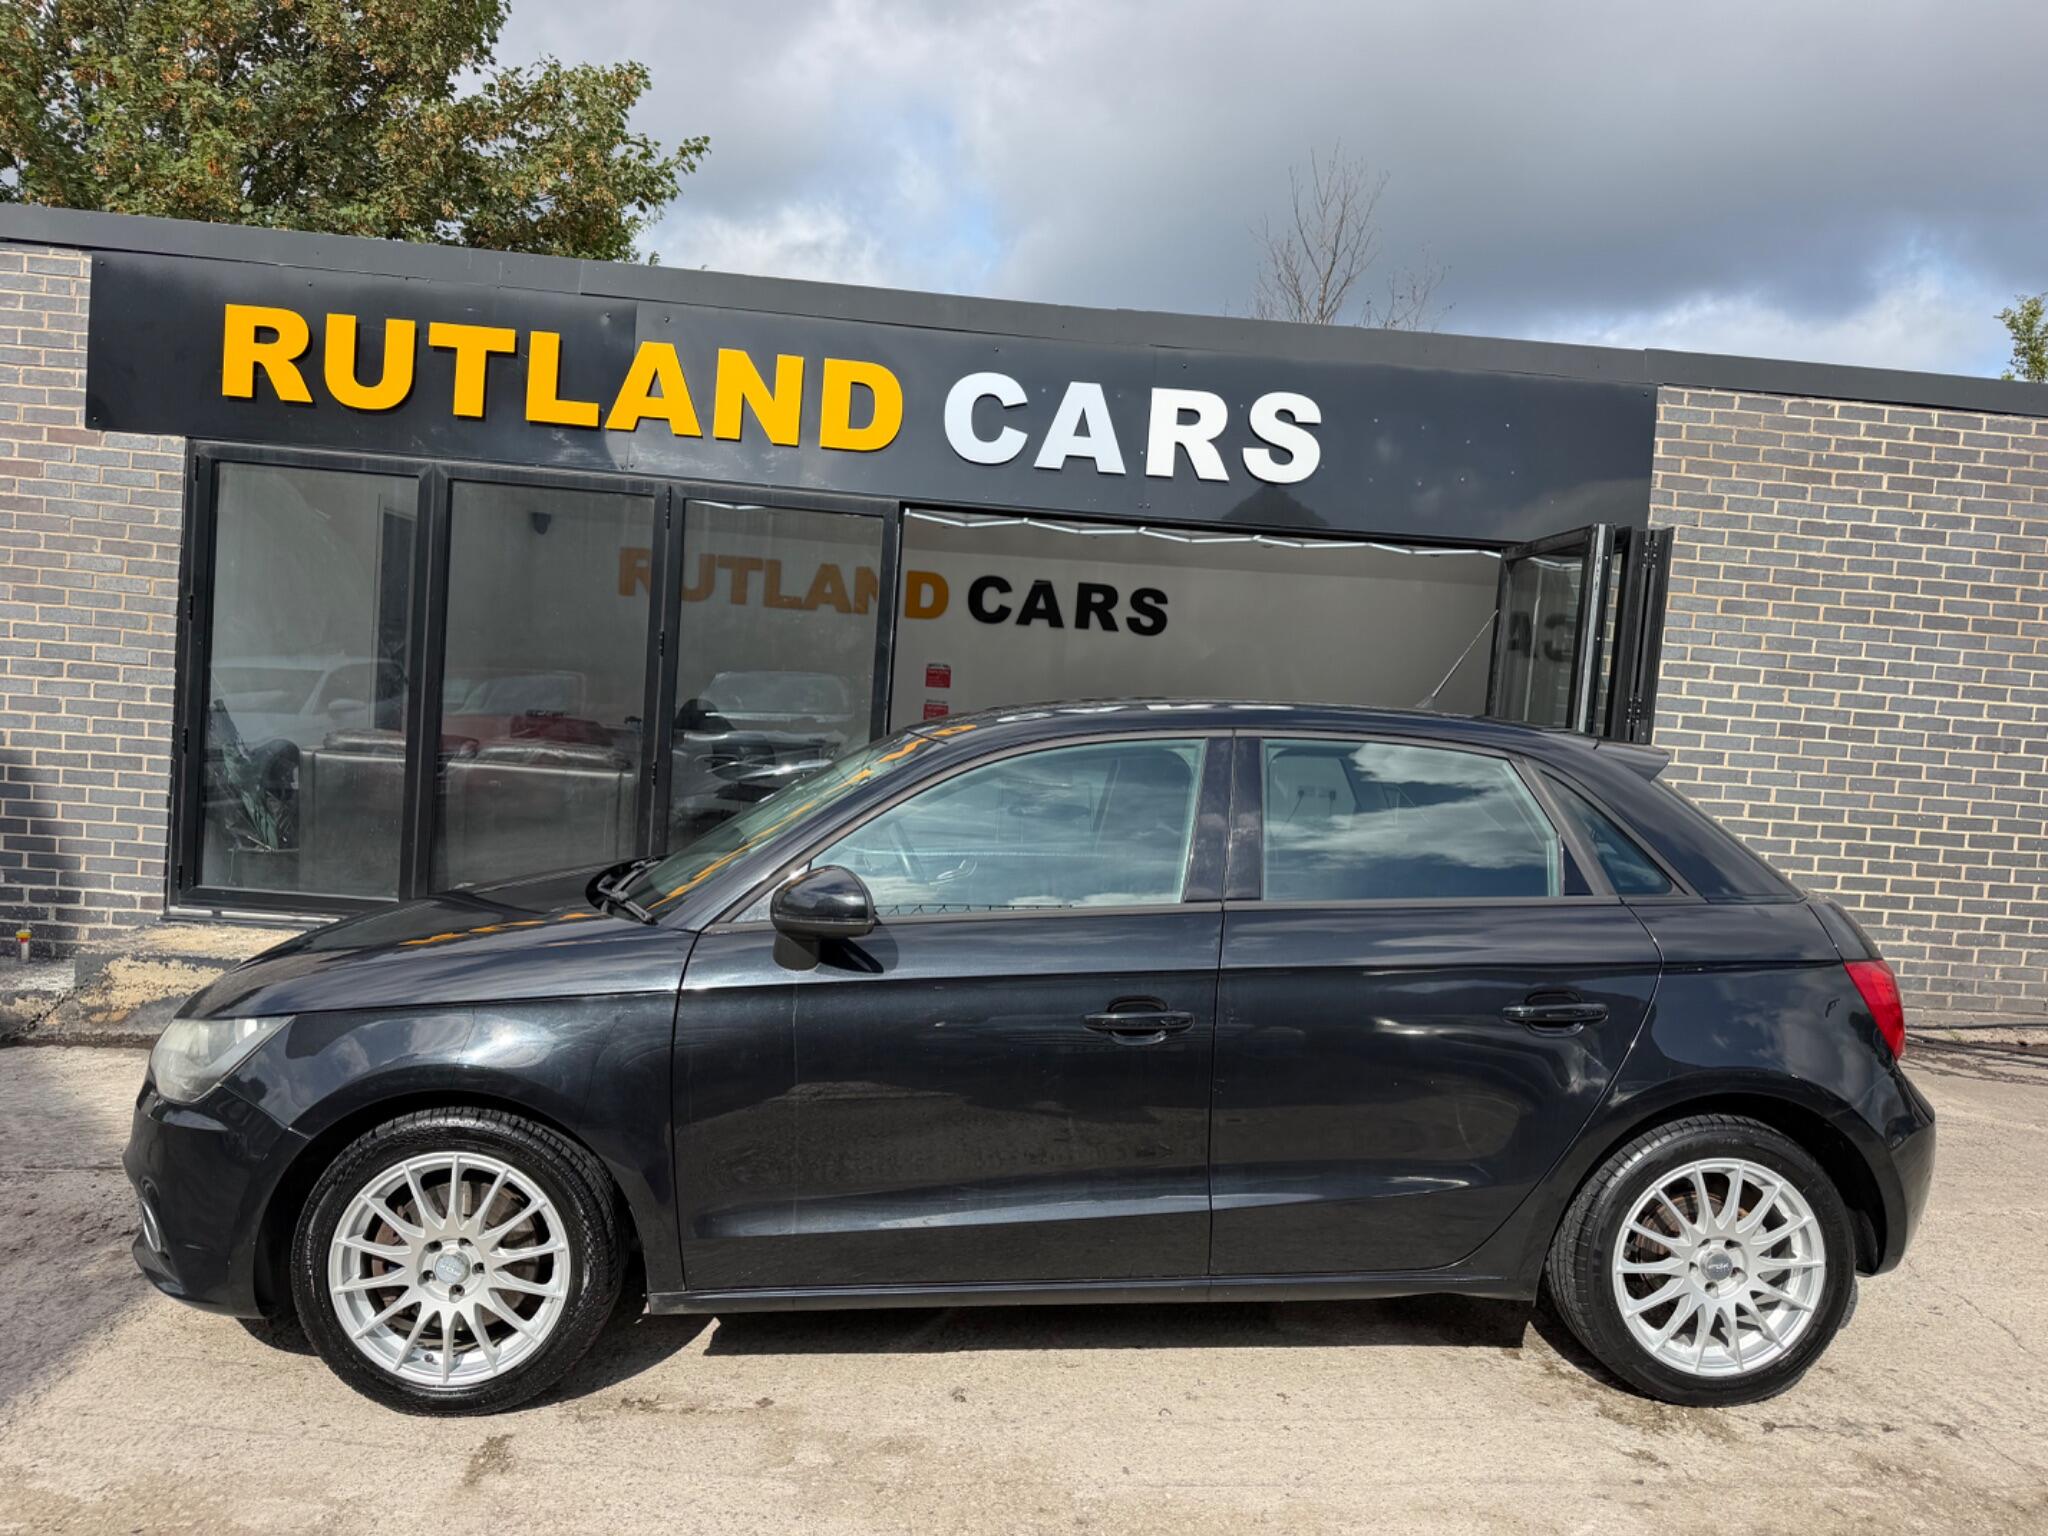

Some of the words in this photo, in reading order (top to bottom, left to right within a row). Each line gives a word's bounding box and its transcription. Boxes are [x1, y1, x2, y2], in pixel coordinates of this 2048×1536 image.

[221, 303, 904, 451] RUTLAND
[943, 372, 1322, 484] CARS
[967, 575, 1169, 636] CARS
